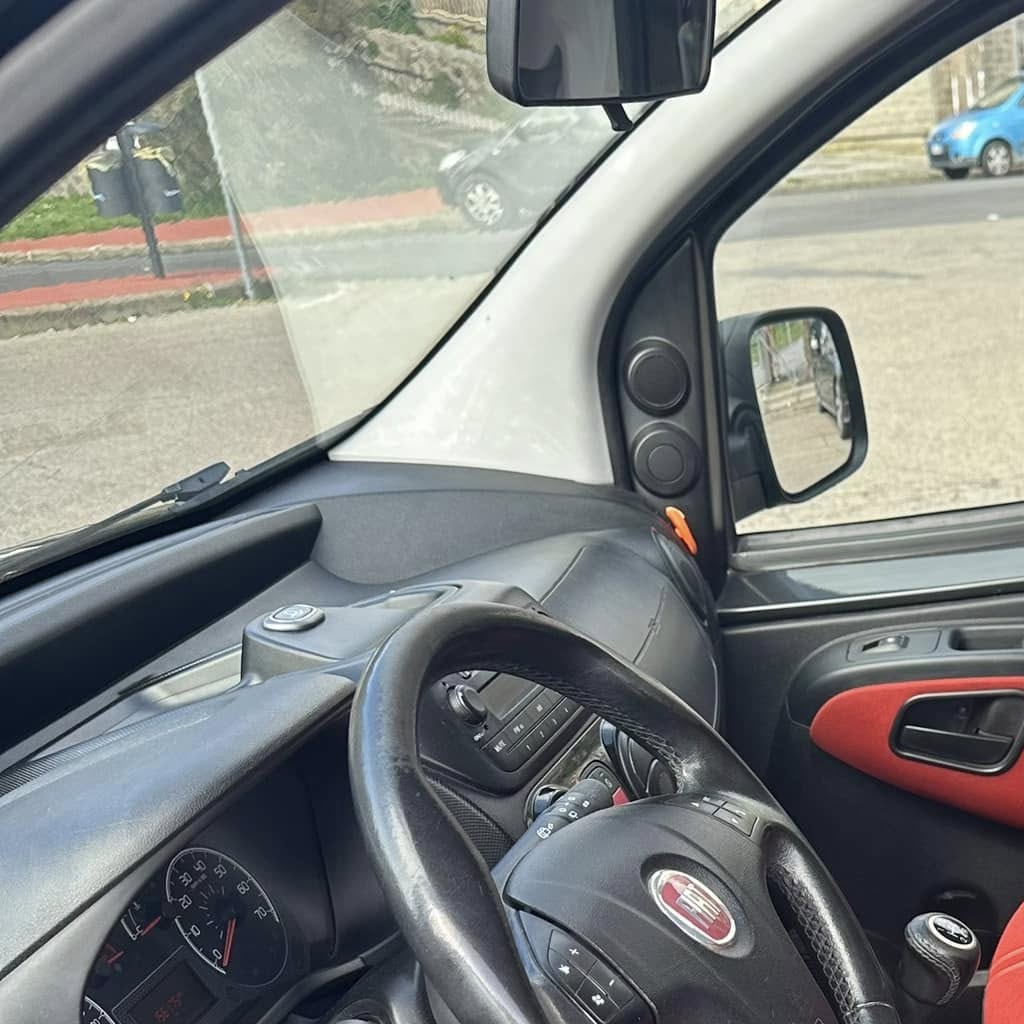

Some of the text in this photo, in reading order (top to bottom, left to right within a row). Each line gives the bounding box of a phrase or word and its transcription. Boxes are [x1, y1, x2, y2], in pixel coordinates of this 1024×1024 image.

[213, 864, 227, 879] 50
[179, 872, 193, 887] 30
[236, 880, 250, 895] 60
[179, 894, 193, 910] 20
[253, 906, 268, 920] 70
